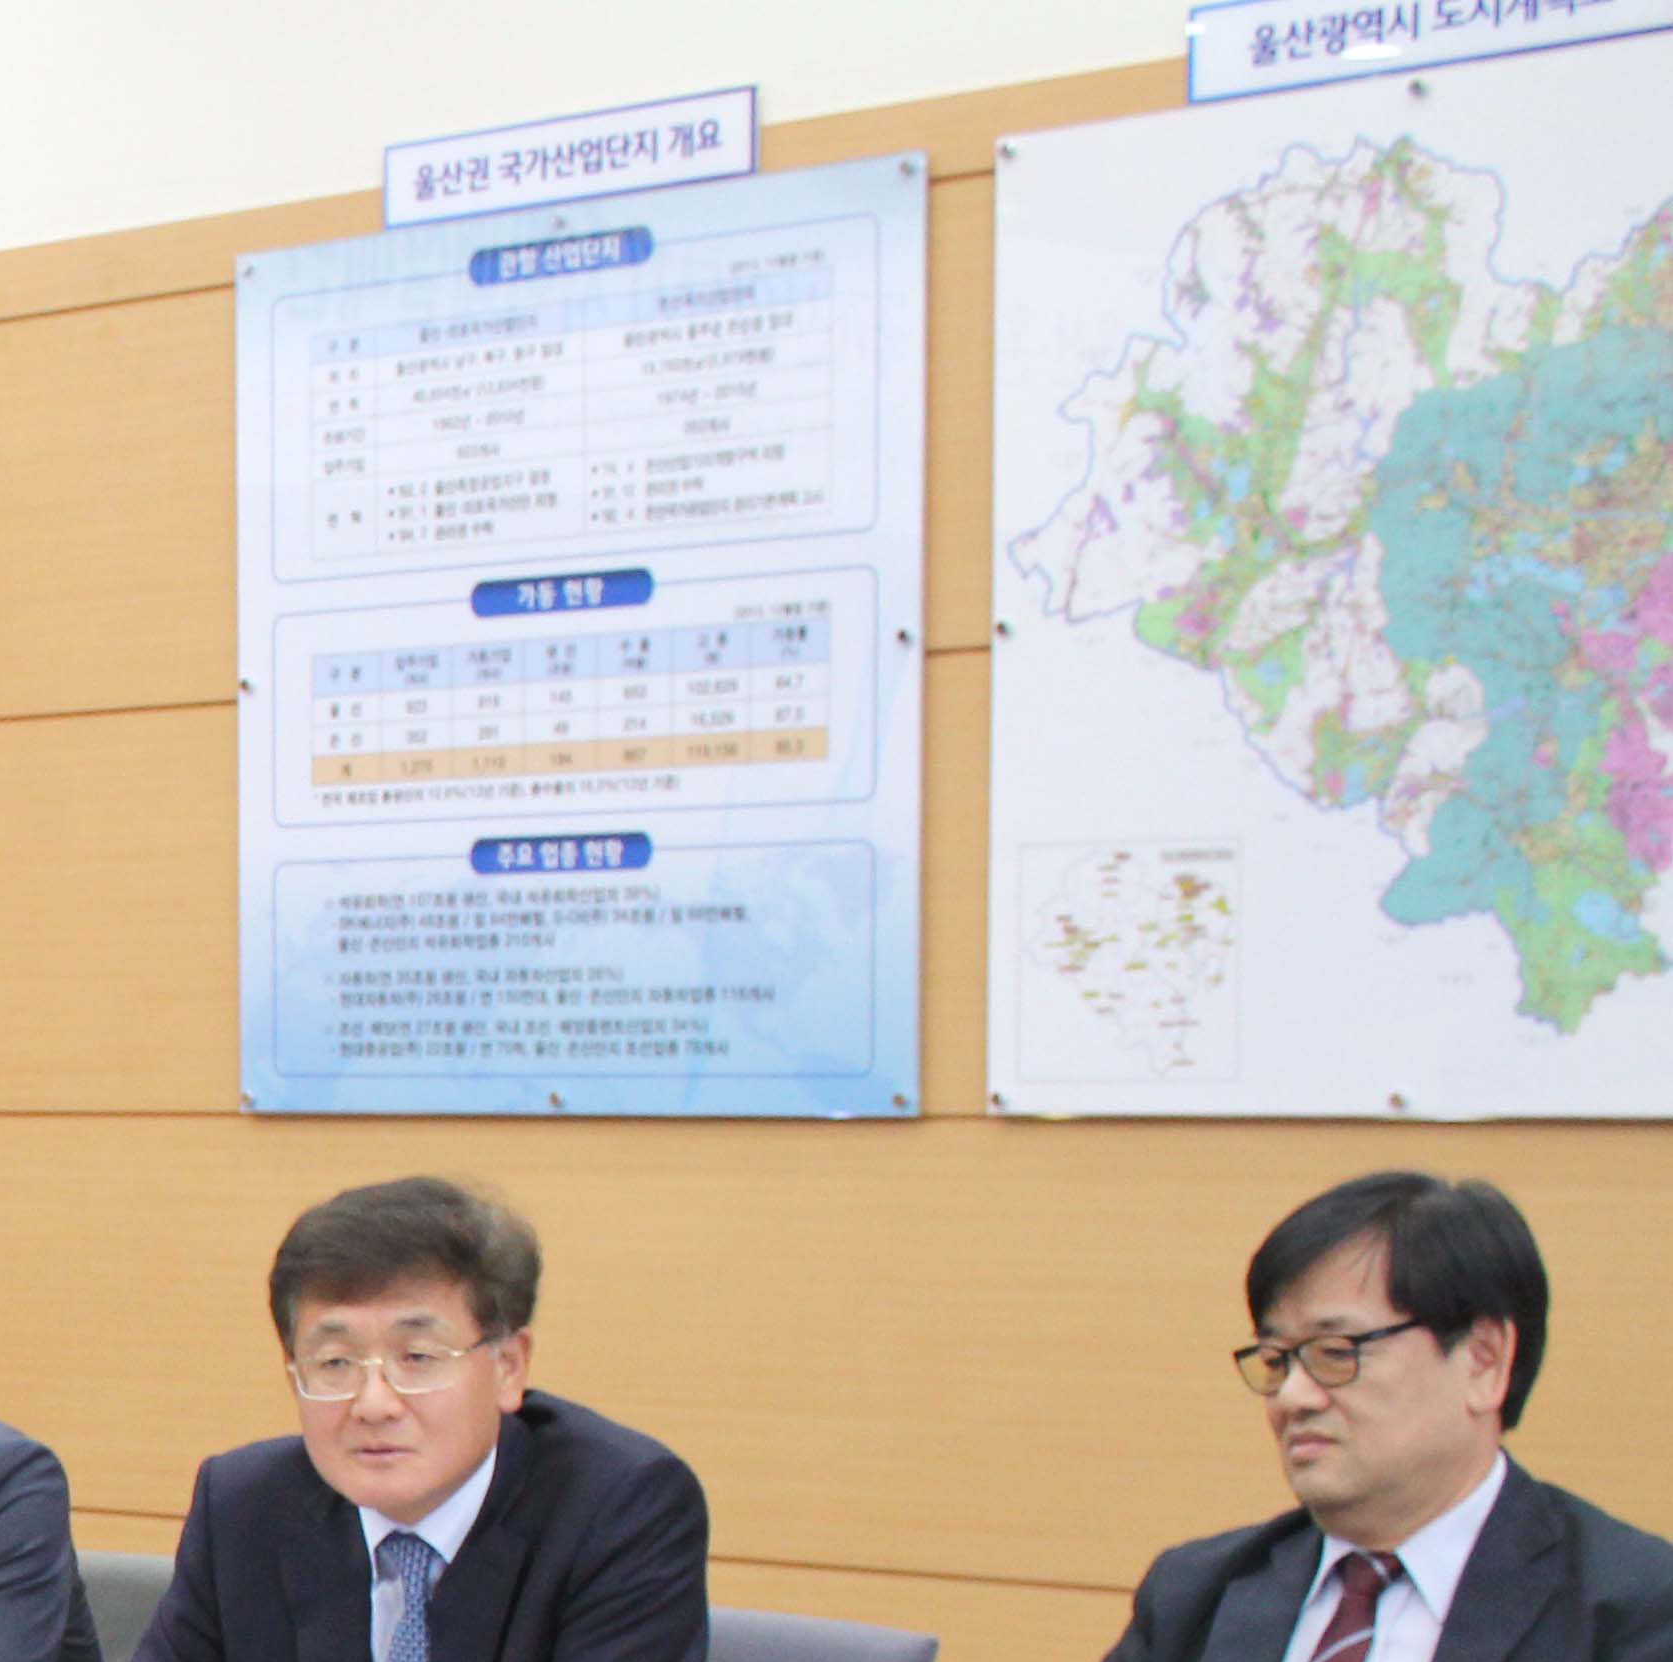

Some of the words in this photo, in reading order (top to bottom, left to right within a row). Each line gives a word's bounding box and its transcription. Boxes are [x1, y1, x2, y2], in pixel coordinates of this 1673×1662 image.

[1249, 3, 1421, 68] 울산광역시
[1431, 0, 1617, 33] 도시계
[414, 155, 490, 202] 울산권
[498, 129, 659, 185] 국가산업단지
[668, 118, 723, 160] 개요
